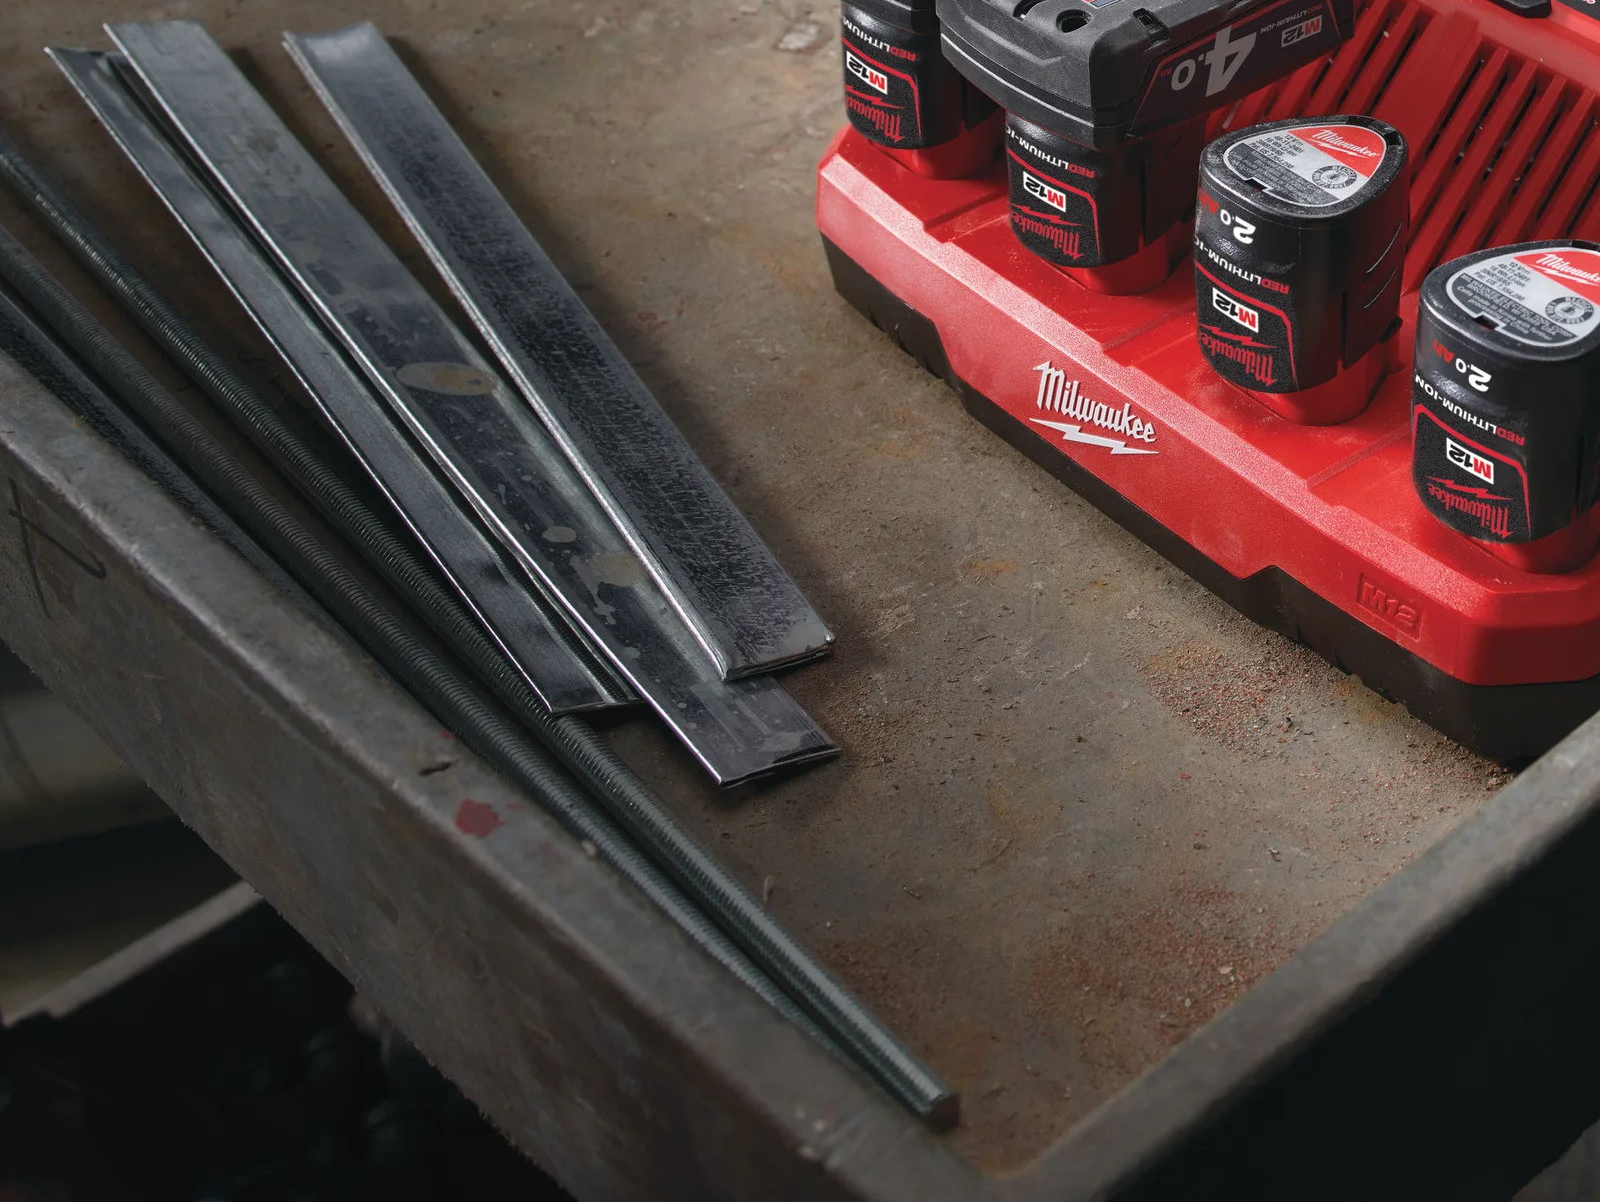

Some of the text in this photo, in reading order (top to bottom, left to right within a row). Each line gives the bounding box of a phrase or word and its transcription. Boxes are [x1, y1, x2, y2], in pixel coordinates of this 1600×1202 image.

[1260, 3, 1322, 34] REDLITHIUM-ION
[1282, 16, 1321, 46] M12
[847, 55, 886, 92] M12
[1171, 25, 1257, 97] 4.0
[1312, 129, 1376, 157] Milwaukee
[1025, 175, 1065, 209] M12
[1011, 210, 1084, 260] Milwauke
[1220, 209, 1256, 245] 2.0
[1486, 278, 1498, 286] US
[1497, 269, 1508, 277] Wh
[1498, 263, 1531, 282] 48-11-2401
[1457, 286, 1473, 296] Cells
[1500, 296, 1534, 316] ELECTRIC
[1214, 290, 1258, 330] M12
[1467, 298, 1503, 320] processing
[1510, 321, 1529, 334] China
[1541, 324, 1556, 336] USA
[1200, 331, 1278, 387] Milwauke
[1433, 339, 1492, 392] 2.0 Ah
[1032, 360, 1157, 443] Milwaukee
[1415, 373, 1525, 447] REDLITHIUM-ION
[1447, 439, 1493, 482] M12
[1427, 482, 1514, 539] Milwaukee
[1362, 582, 1417, 628] M12
